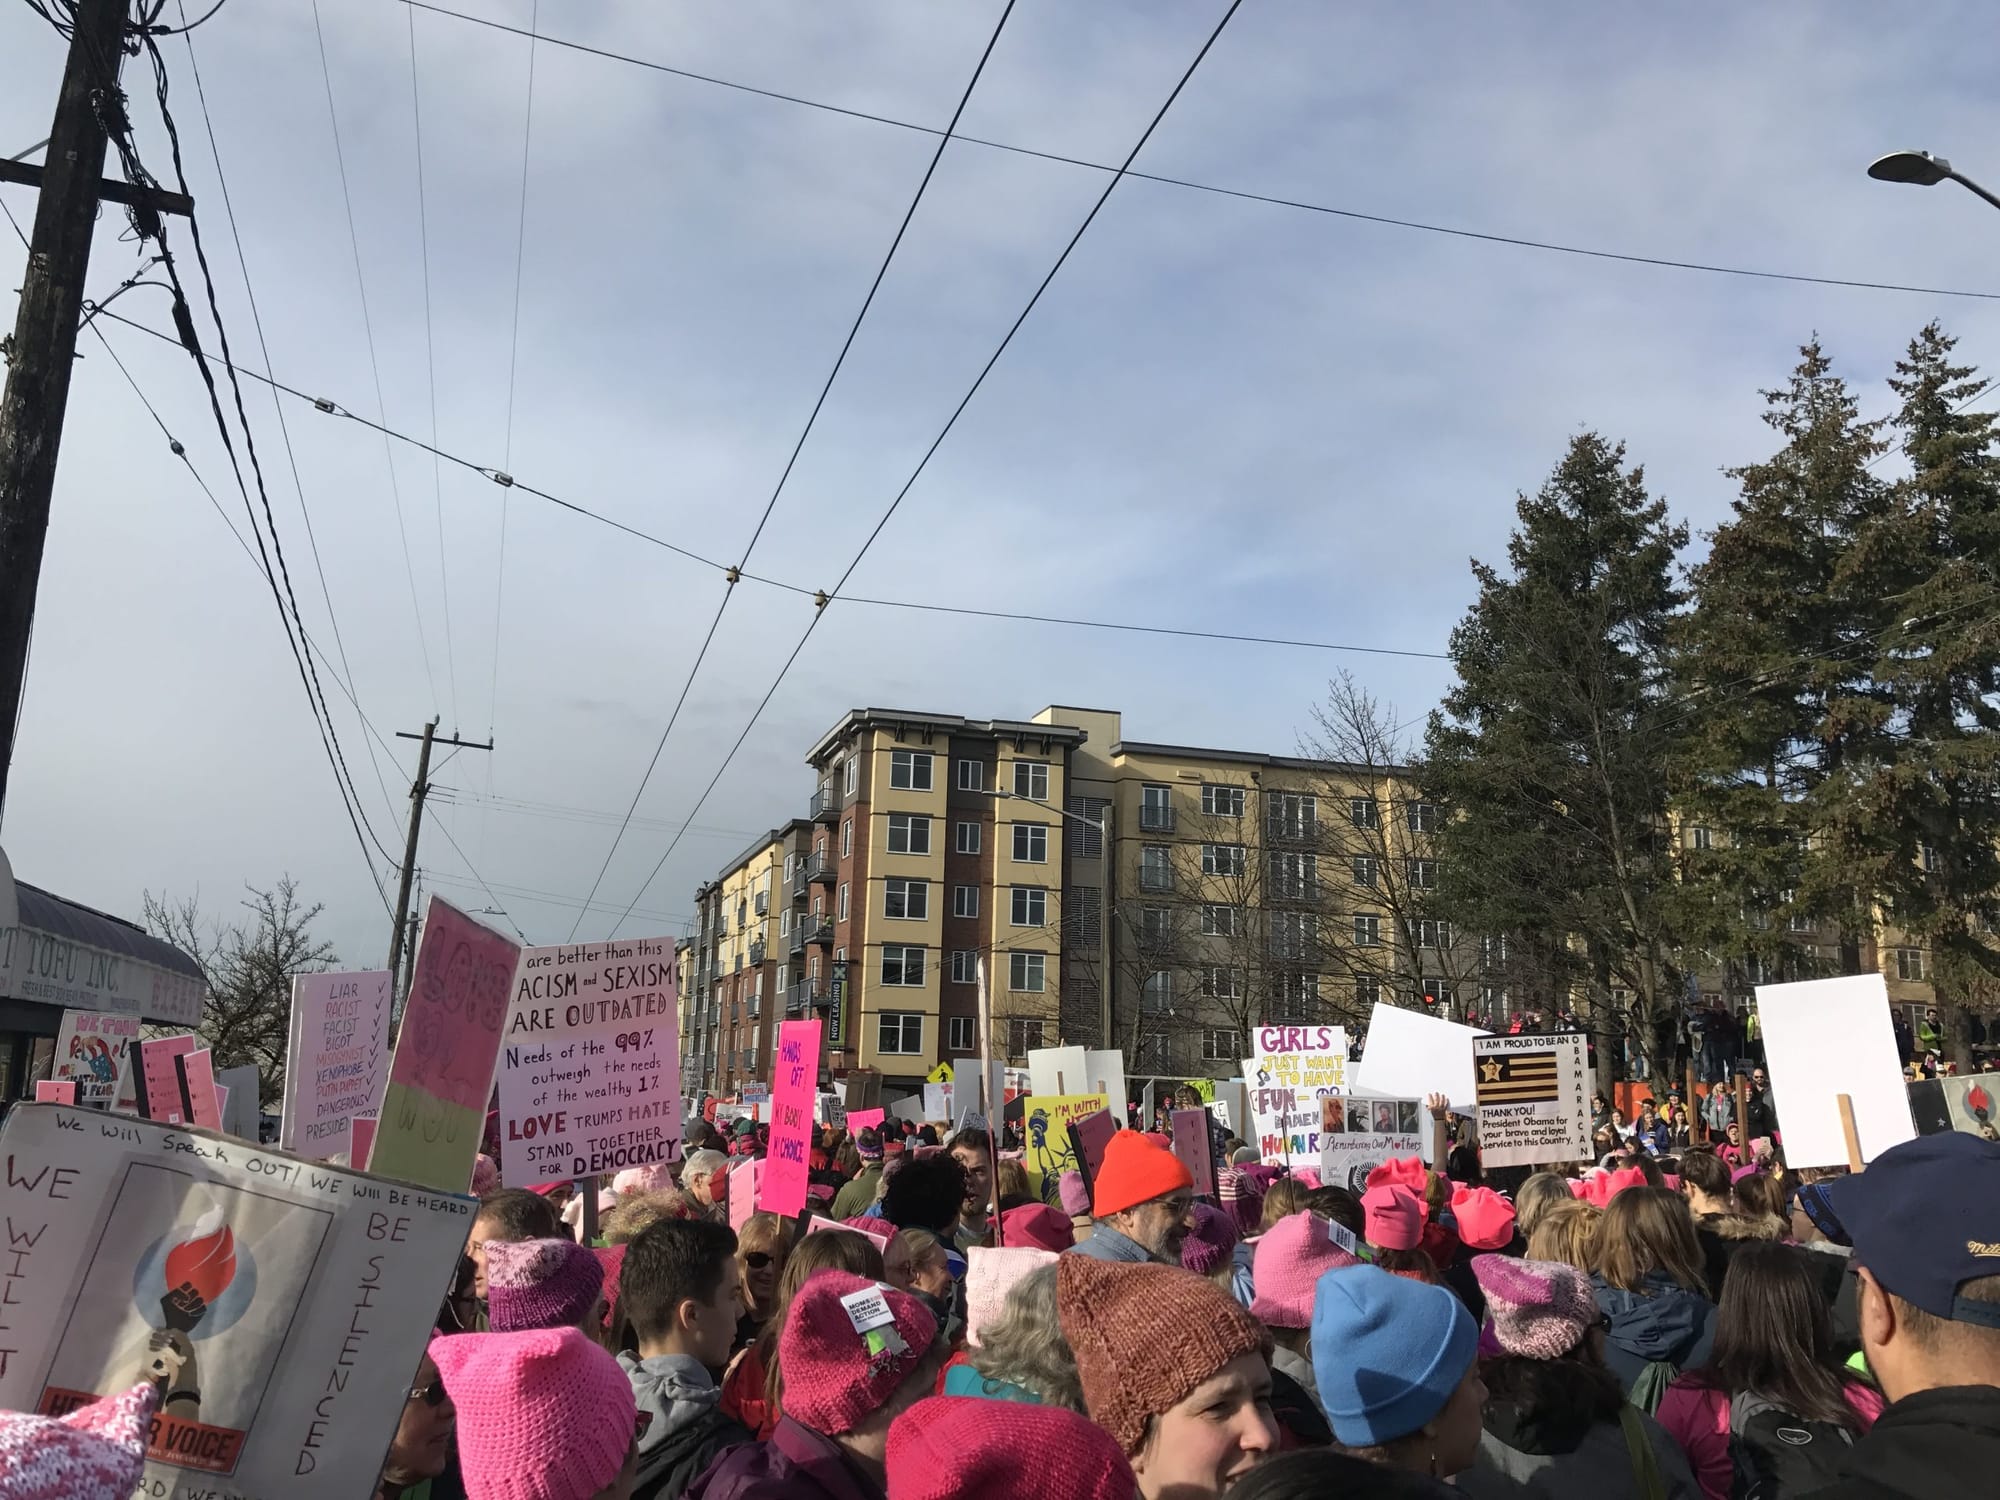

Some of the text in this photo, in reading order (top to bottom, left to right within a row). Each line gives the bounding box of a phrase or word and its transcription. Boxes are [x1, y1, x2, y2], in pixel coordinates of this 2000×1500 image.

[27, 934, 80, 983] TOFU
[527, 939, 662, 969] are better than this
[329, 983, 358, 999] LIAR
[516, 962, 673, 1002] ACISM and SEXISM
[325, 1000, 362, 1018] RACIST
[511, 993, 667, 1034] ARE OUTDATED
[831, 983, 840, 1039] NOW LEASING
[323, 1018, 360, 1036] FACIST
[1260, 1025, 1332, 1053] GIRLS
[325, 1033, 353, 1051] BIGOT
[506, 1028, 654, 1070] Needs of the 99%
[1480, 1036, 1569, 1049] I AM PROUD TO BE AN
[316, 1061, 364, 1086] XENOPHOBE
[531, 1066, 591, 1086] outweigh
[604, 1058, 625, 1074] the
[631, 1052, 661, 1072] needs
[1261, 1054, 1345, 1072] JUST WANT
[533, 1075, 659, 1106] of the wealthy 1%
[1276, 1070, 1344, 1087] TO HAVE
[317, 1094, 365, 1118] DANGEROUS
[1055, 1098, 1101, 1118] I'M WITH
[1482, 1104, 1536, 1118] THANK YOU!
[508, 1100, 671, 1141] LOVE TRUMPS HATE
[1482, 1115, 1568, 1129] President Obama for
[527, 1126, 663, 1163] STAND TOGETHER
[1483, 1126, 1566, 1141] your brave and loyal
[1483, 1139, 1513, 1150] service
[1513, 1138, 1523, 1147] to
[1524, 1136, 1539, 1146] this
[57, 1113, 84, 1131] We
[102, 1124, 142, 1145] Will
[311, 1177, 343, 1194] WE
[389, 1190, 410, 1206] BE
[417, 1196, 468, 1215] HEARD
[539, 1138, 679, 1176] FOR DEMOCRACY
[8, 1155, 80, 1200] WE
[367, 1212, 411, 1242] BE
[849, 1299, 870, 1309] MOMS
[851, 1301, 881, 1315] DEMAND
[854, 1307, 881, 1320] ACTION
[165, 1421, 235, 1461] VOICE
